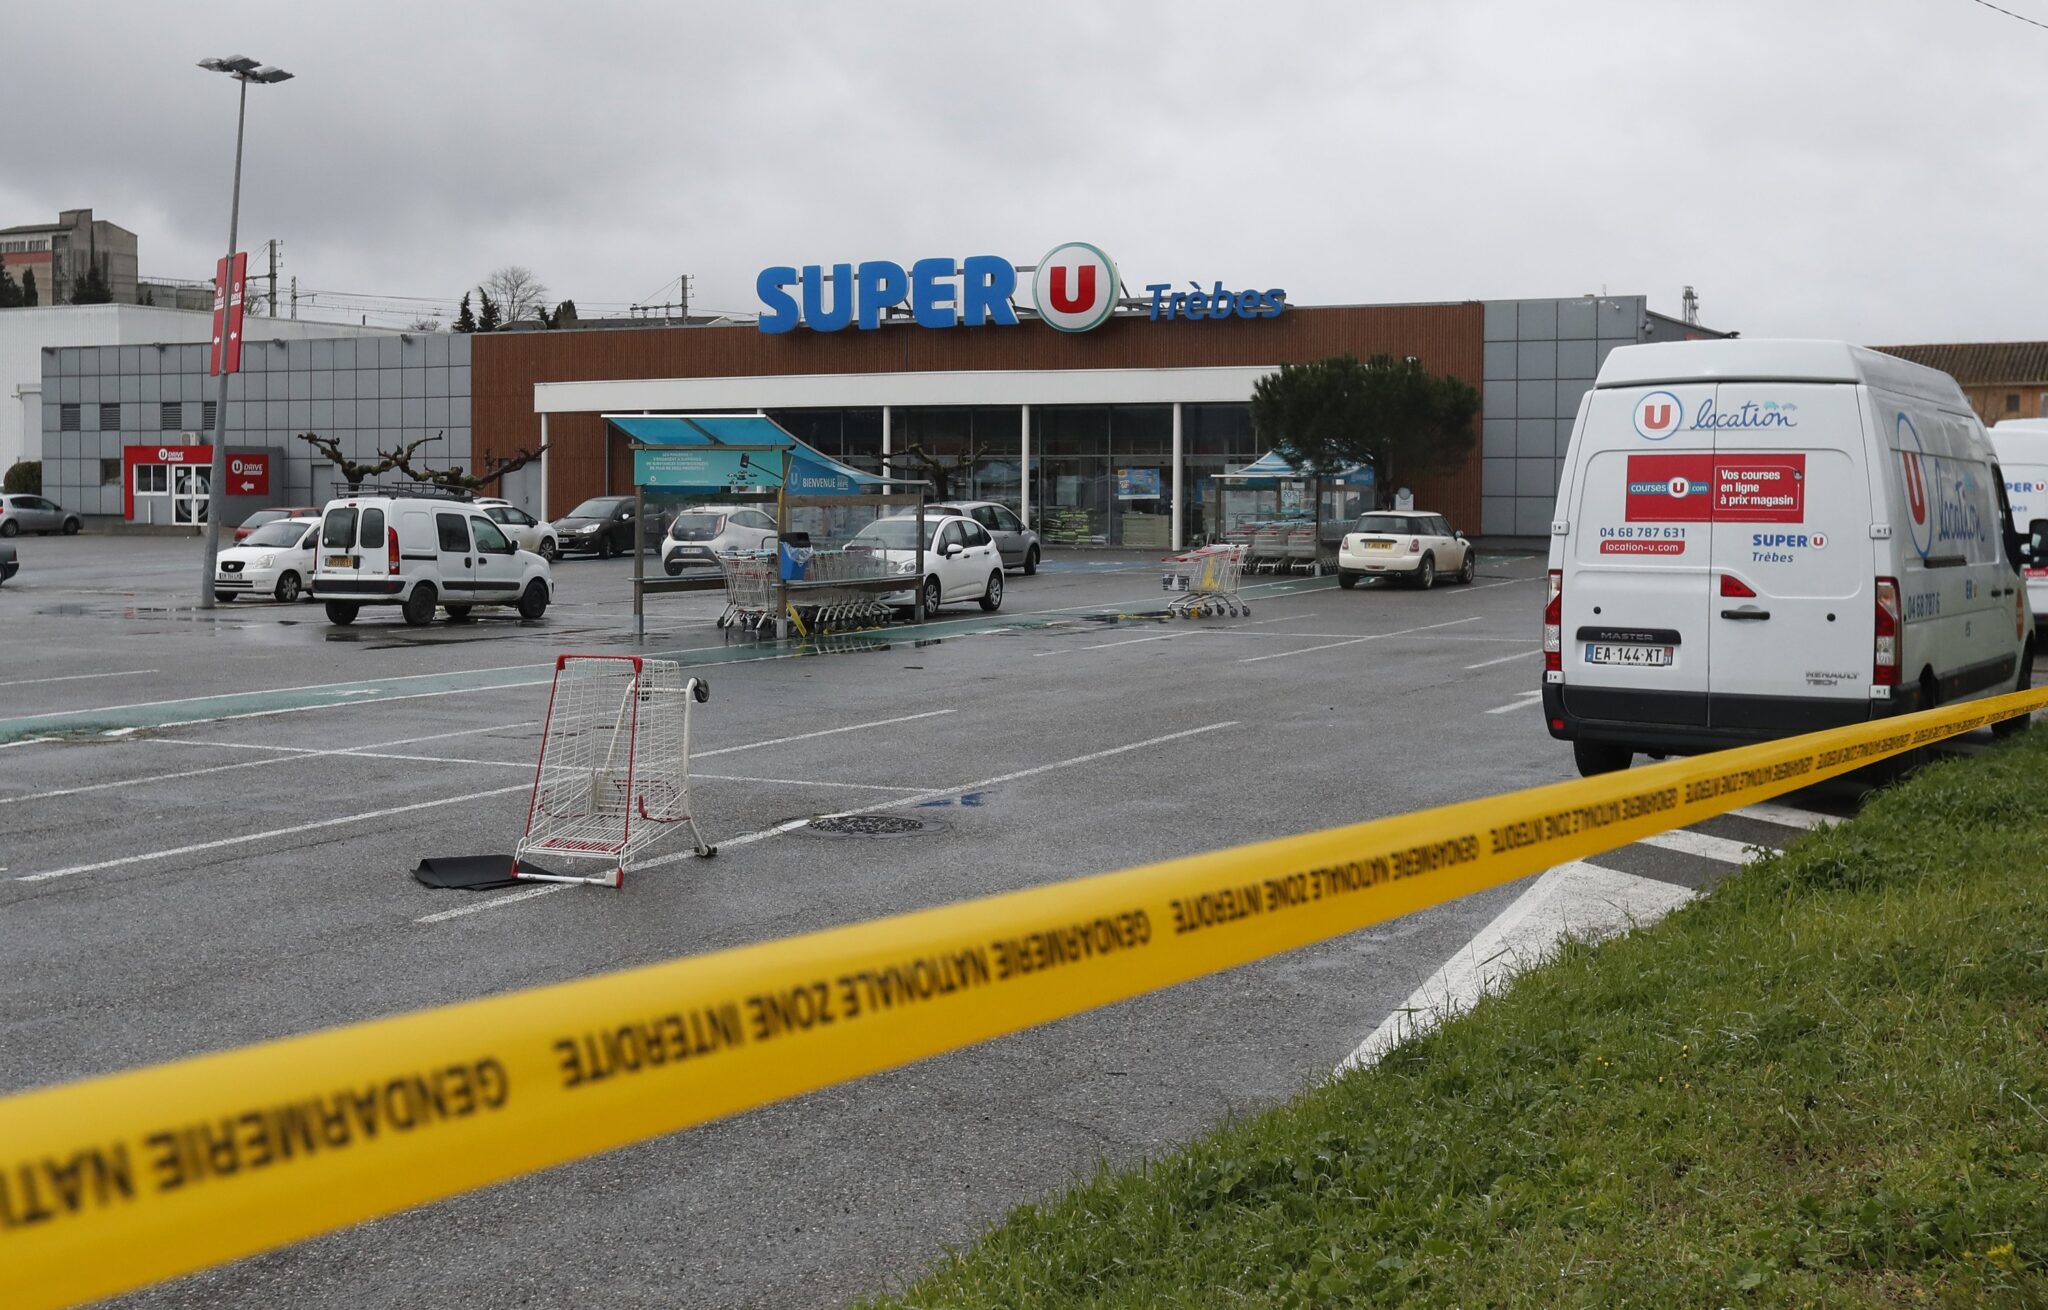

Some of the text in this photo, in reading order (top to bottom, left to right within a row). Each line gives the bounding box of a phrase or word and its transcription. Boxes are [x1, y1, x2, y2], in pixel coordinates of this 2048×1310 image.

[756, 254, 1097, 334] SUPER U
[1145, 279, 1287, 322] Trèbes
[1643, 398, 1799, 431] U location
[243, 463, 264, 471] DRIVE
[1721, 469, 1781, 481] Vos courses
[802, 477, 837, 489] BIENVENUE
[1630, 484, 1667, 494] courses
[1720, 481, 1760, 496] en ligne
[1720, 494, 1727, 506] à
[1750, 495, 1794, 508] magasin
[1901, 450, 1986, 543] U location
[1599, 527, 1686, 539] 04 68 787 631
[1605, 541, 1680, 553] location-u.com
[1752, 533, 1808, 548] SUPER
[1752, 550, 1794, 564] Trèbes
[1600, 631, 1655, 642] MASTER
[1805, 670, 1860, 680] RENAULT
[1169, 833, 1481, 935] GENDARMERIE NATIONALE ZONE INTERDITE
[551, 907, 1153, 1091] GENDARMERIE NATIONALE ZONE INTERDITE
[143, 1056, 510, 1194] GENDARMERIE
